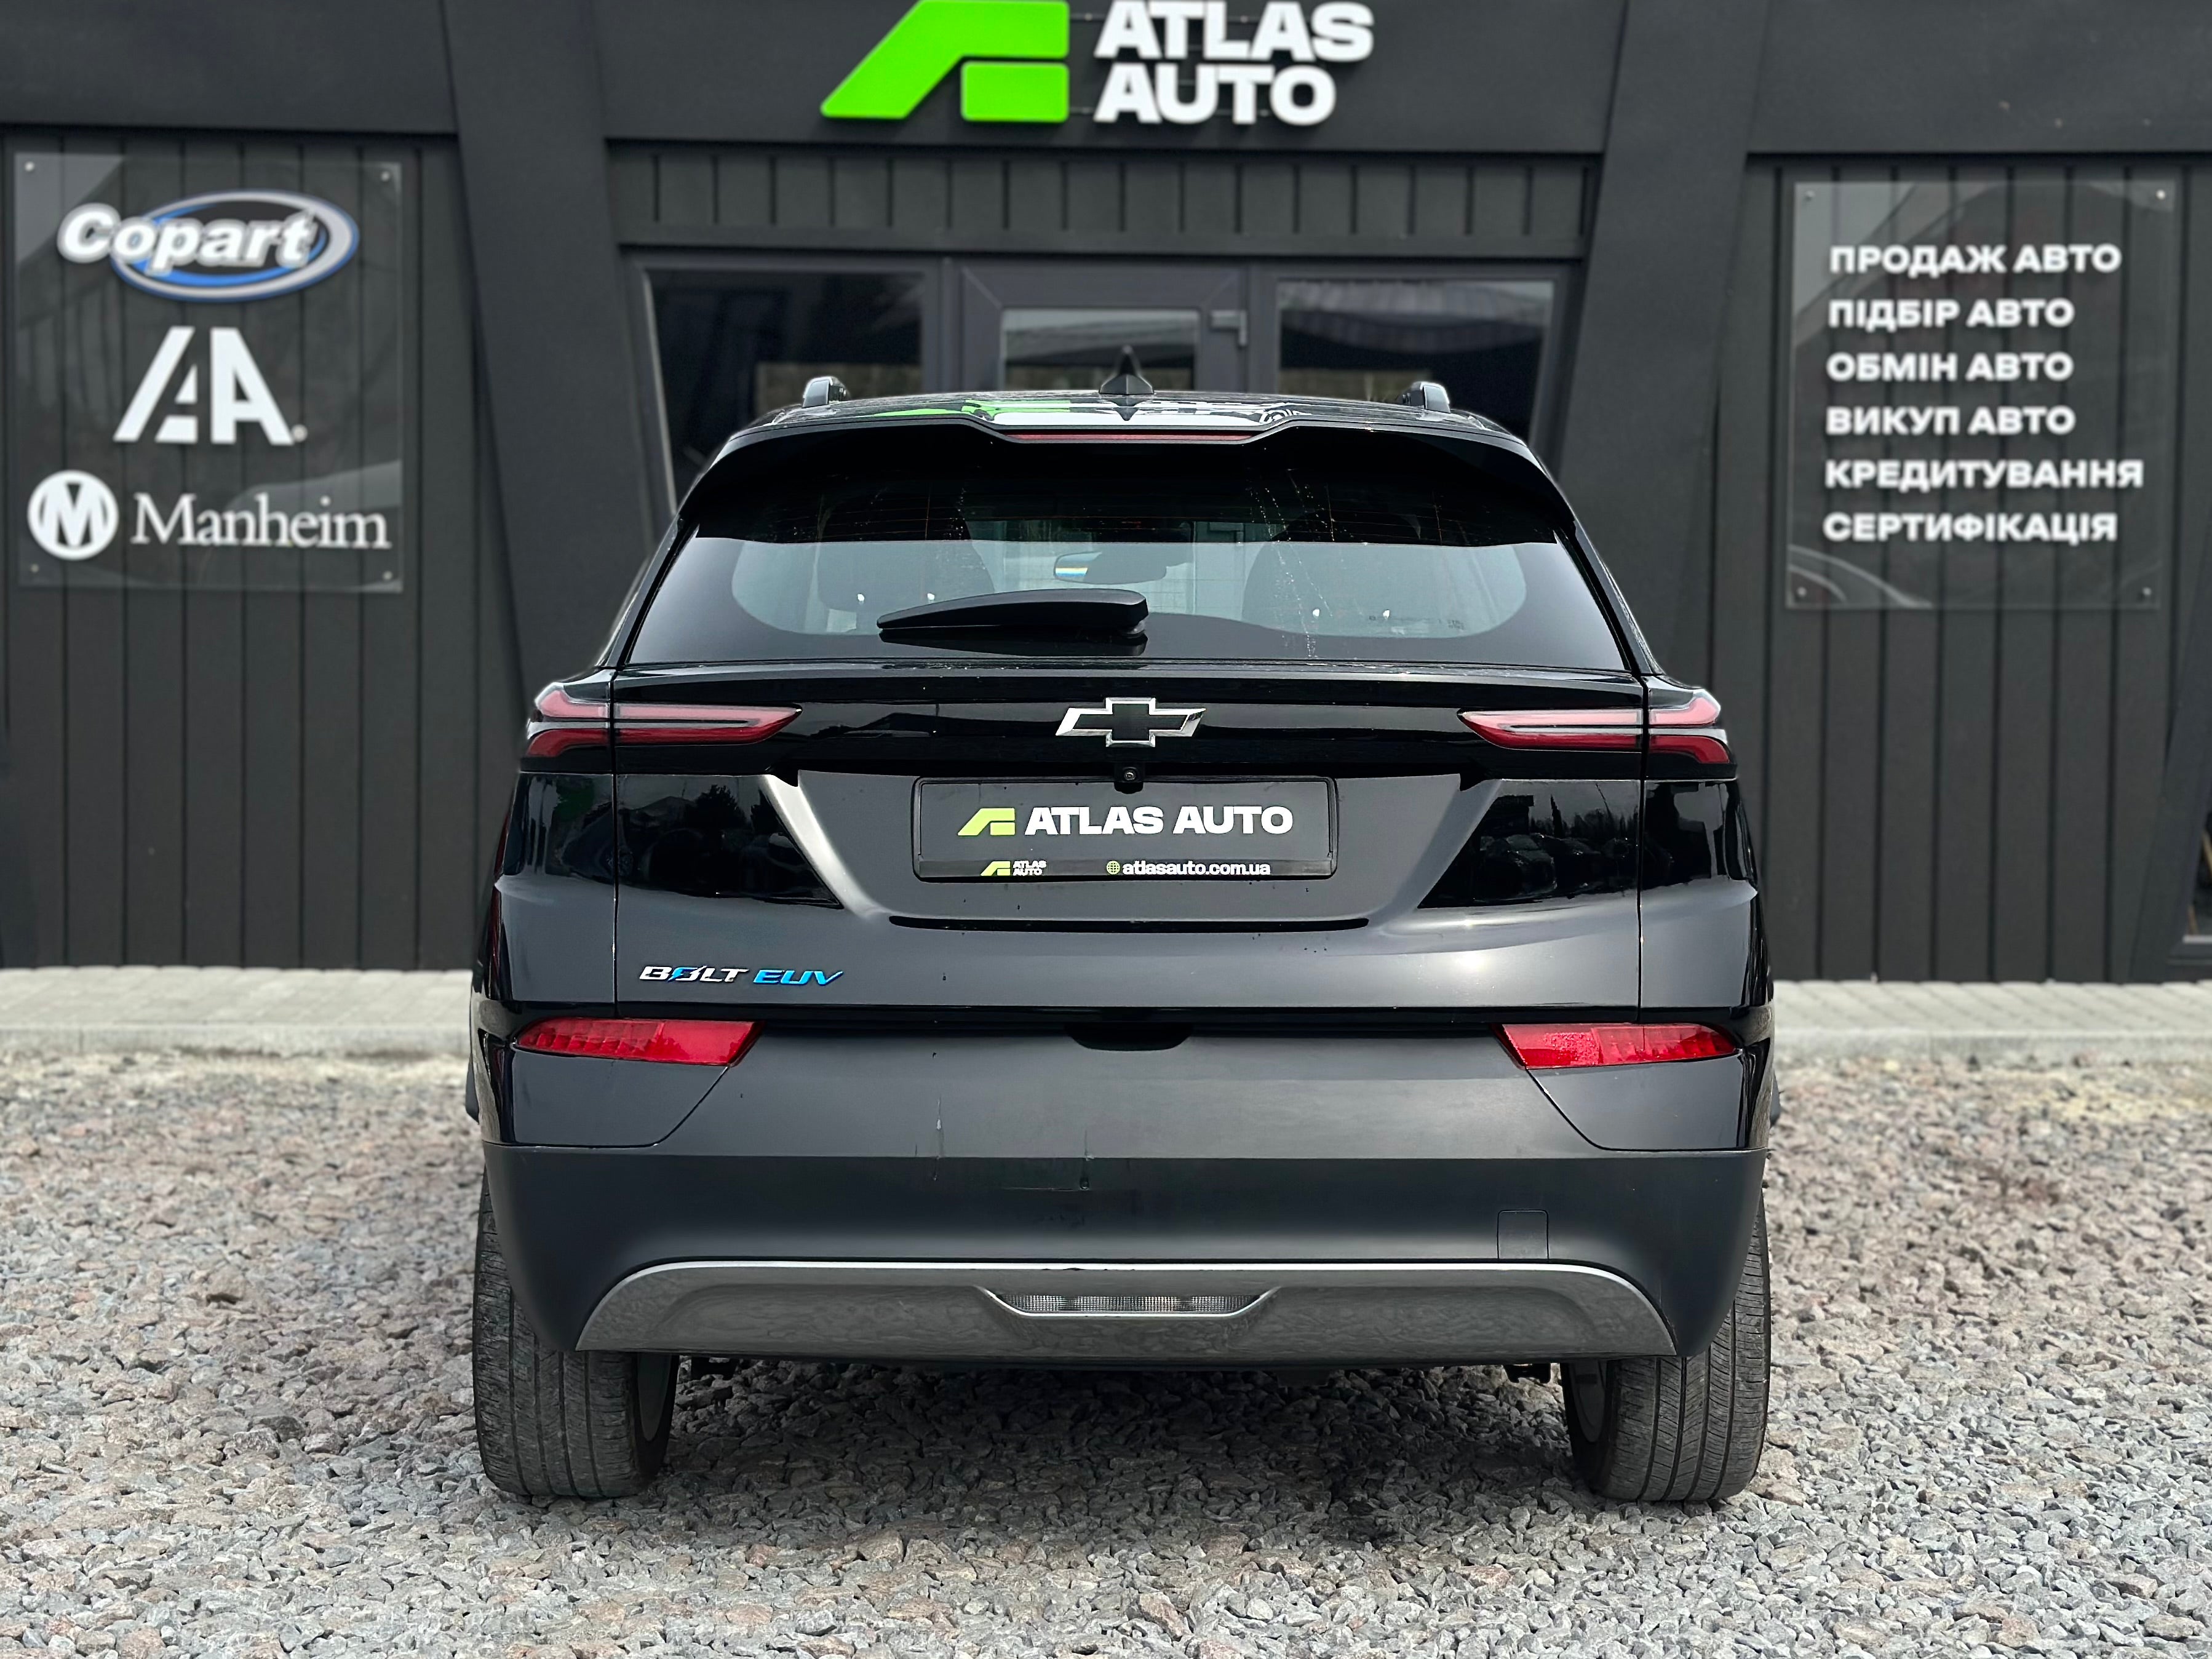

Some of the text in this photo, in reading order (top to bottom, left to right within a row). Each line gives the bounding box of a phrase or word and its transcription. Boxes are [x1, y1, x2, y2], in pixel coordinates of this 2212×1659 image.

[1094, 0, 1374, 62] ATLAS
[1094, 63, 1336, 125] AUTO
[58, 203, 316, 275] Copart
[1829, 244, 2122, 279] ПРОДАЖ АВТО
[1828, 298, 2075, 332] ПІДБІР АВТО
[1826, 352, 2074, 381] ОБМІН АВТО
[1826, 405, 2076, 435] ВИКУП АВТО
[1825, 459, 2144, 493] КРЕДИТУВАННЯ
[131, 491, 391, 549] Manheim
[1823, 512, 2117, 546] СЕРТИФІКАЦІЯ
[1025, 806, 1294, 835] ATLAS AUTO
[1013, 860, 1047, 869] ATLAS
[1013, 868, 1043, 877] AUTO
[1122, 860, 1271, 875] atlasauto.com.ua
[639, 965, 843, 985] BOLT EUV
